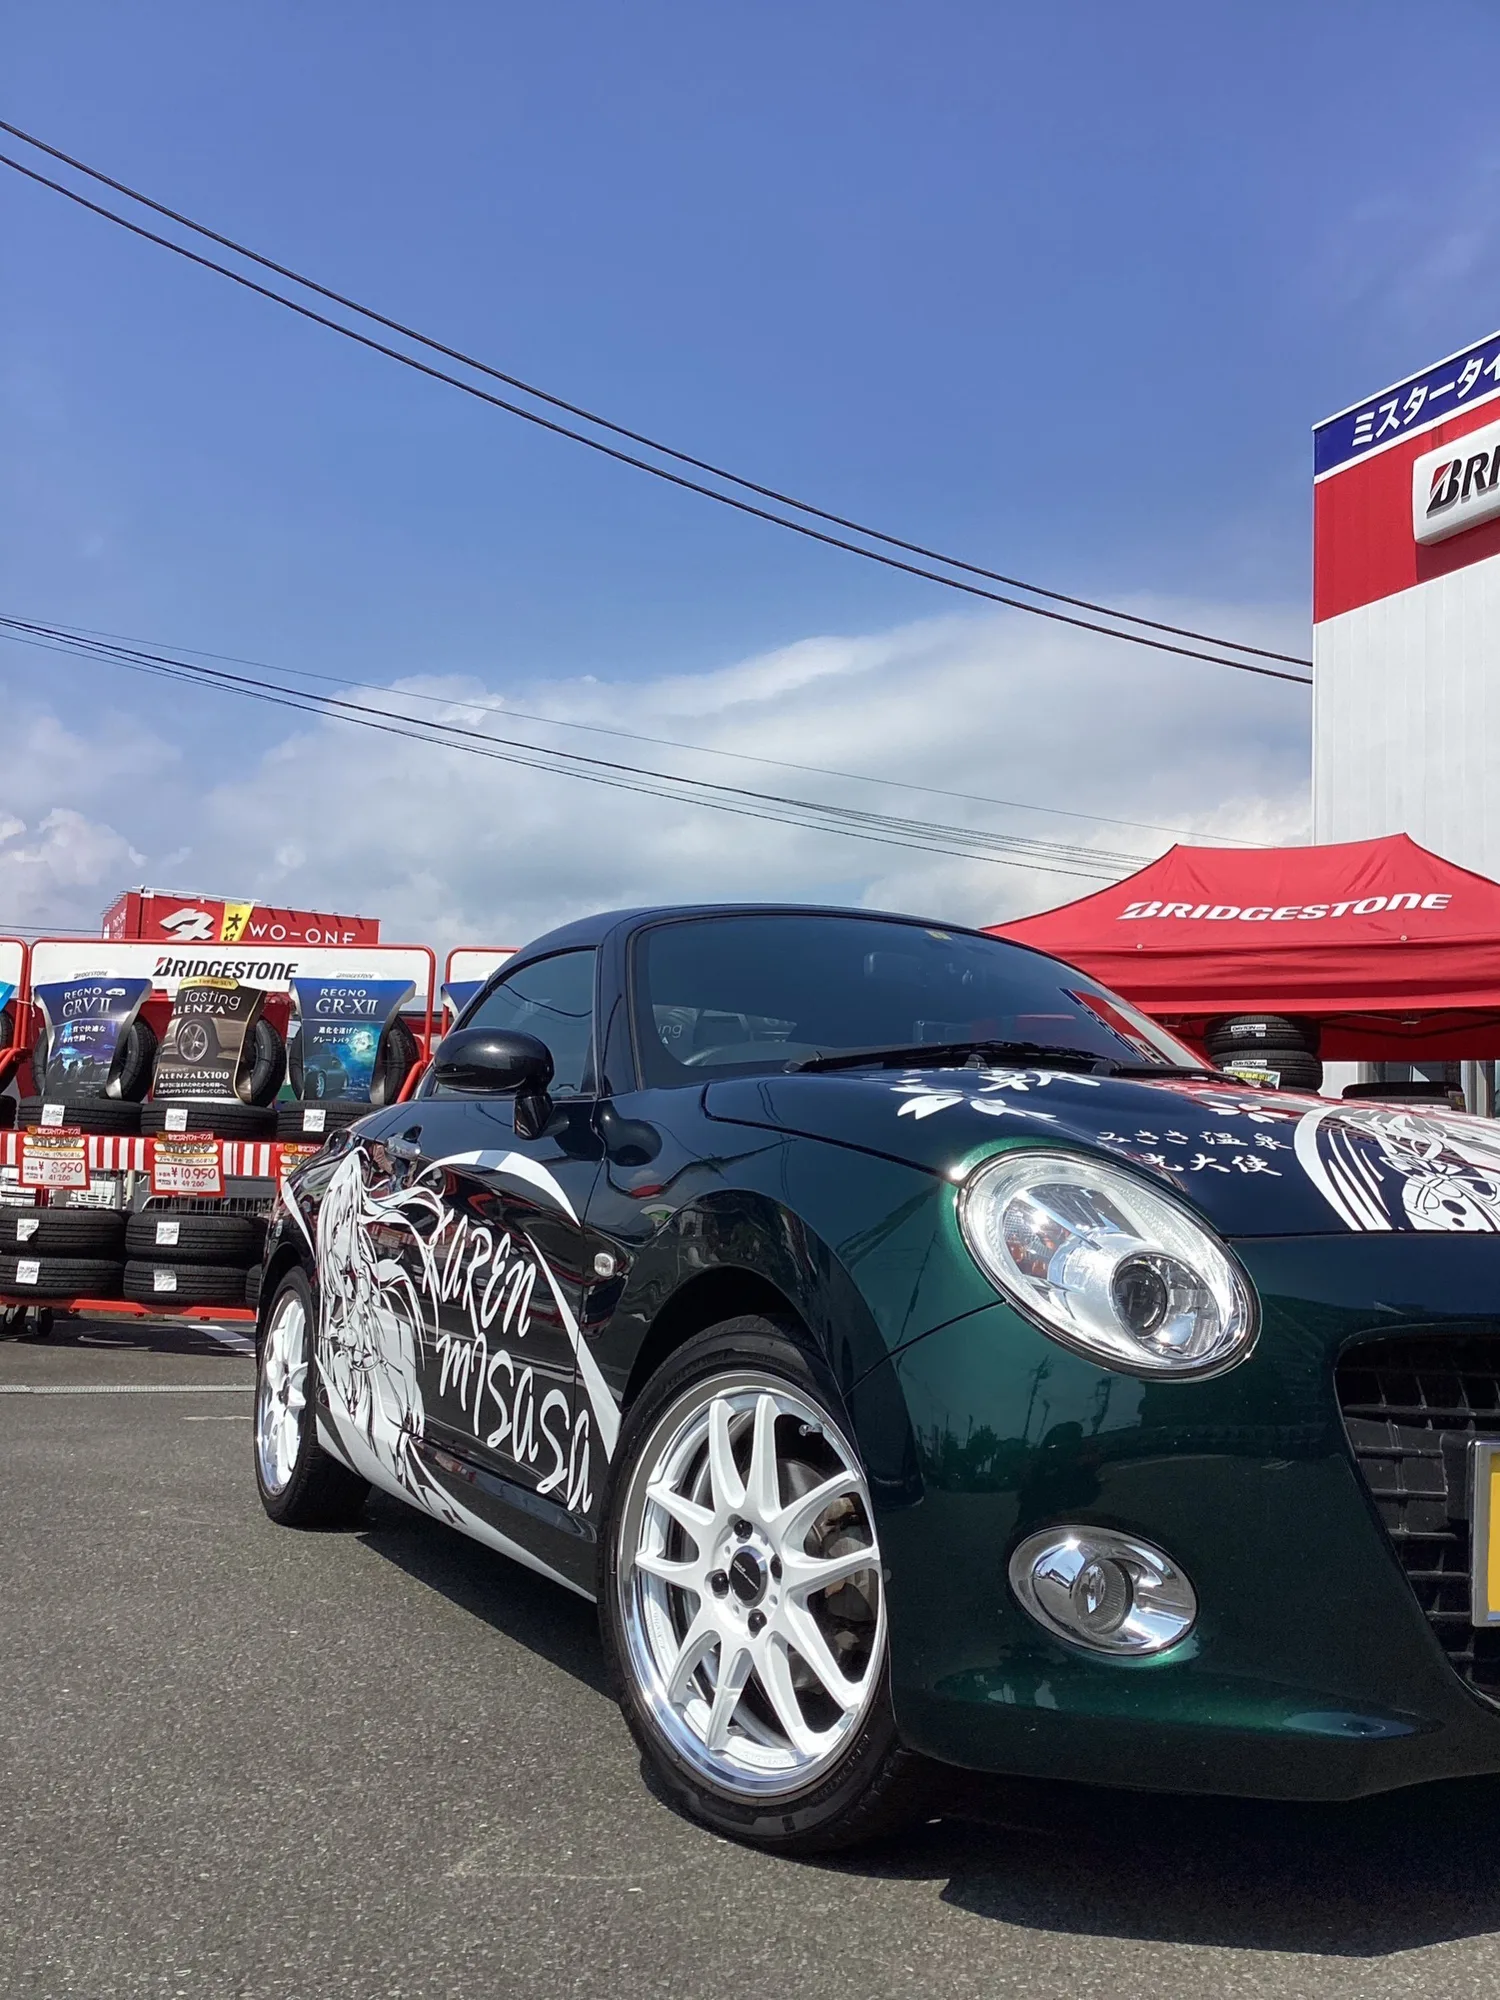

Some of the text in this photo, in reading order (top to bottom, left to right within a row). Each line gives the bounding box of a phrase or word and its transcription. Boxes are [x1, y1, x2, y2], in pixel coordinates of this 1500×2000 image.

[1115, 892, 1453, 922] BRIDGESTONE
[152, 957, 298, 981] BRIDGESTONE
[64, 987, 102, 1000] REGNO
[185, 989, 242, 1011] Tasting
[320, 988, 367, 997] REGNO
[62, 997, 98, 1018] GRV
[1096, 1129, 1293, 1151] みささ温泉
[1140, 1151, 1284, 1177] 光大使
